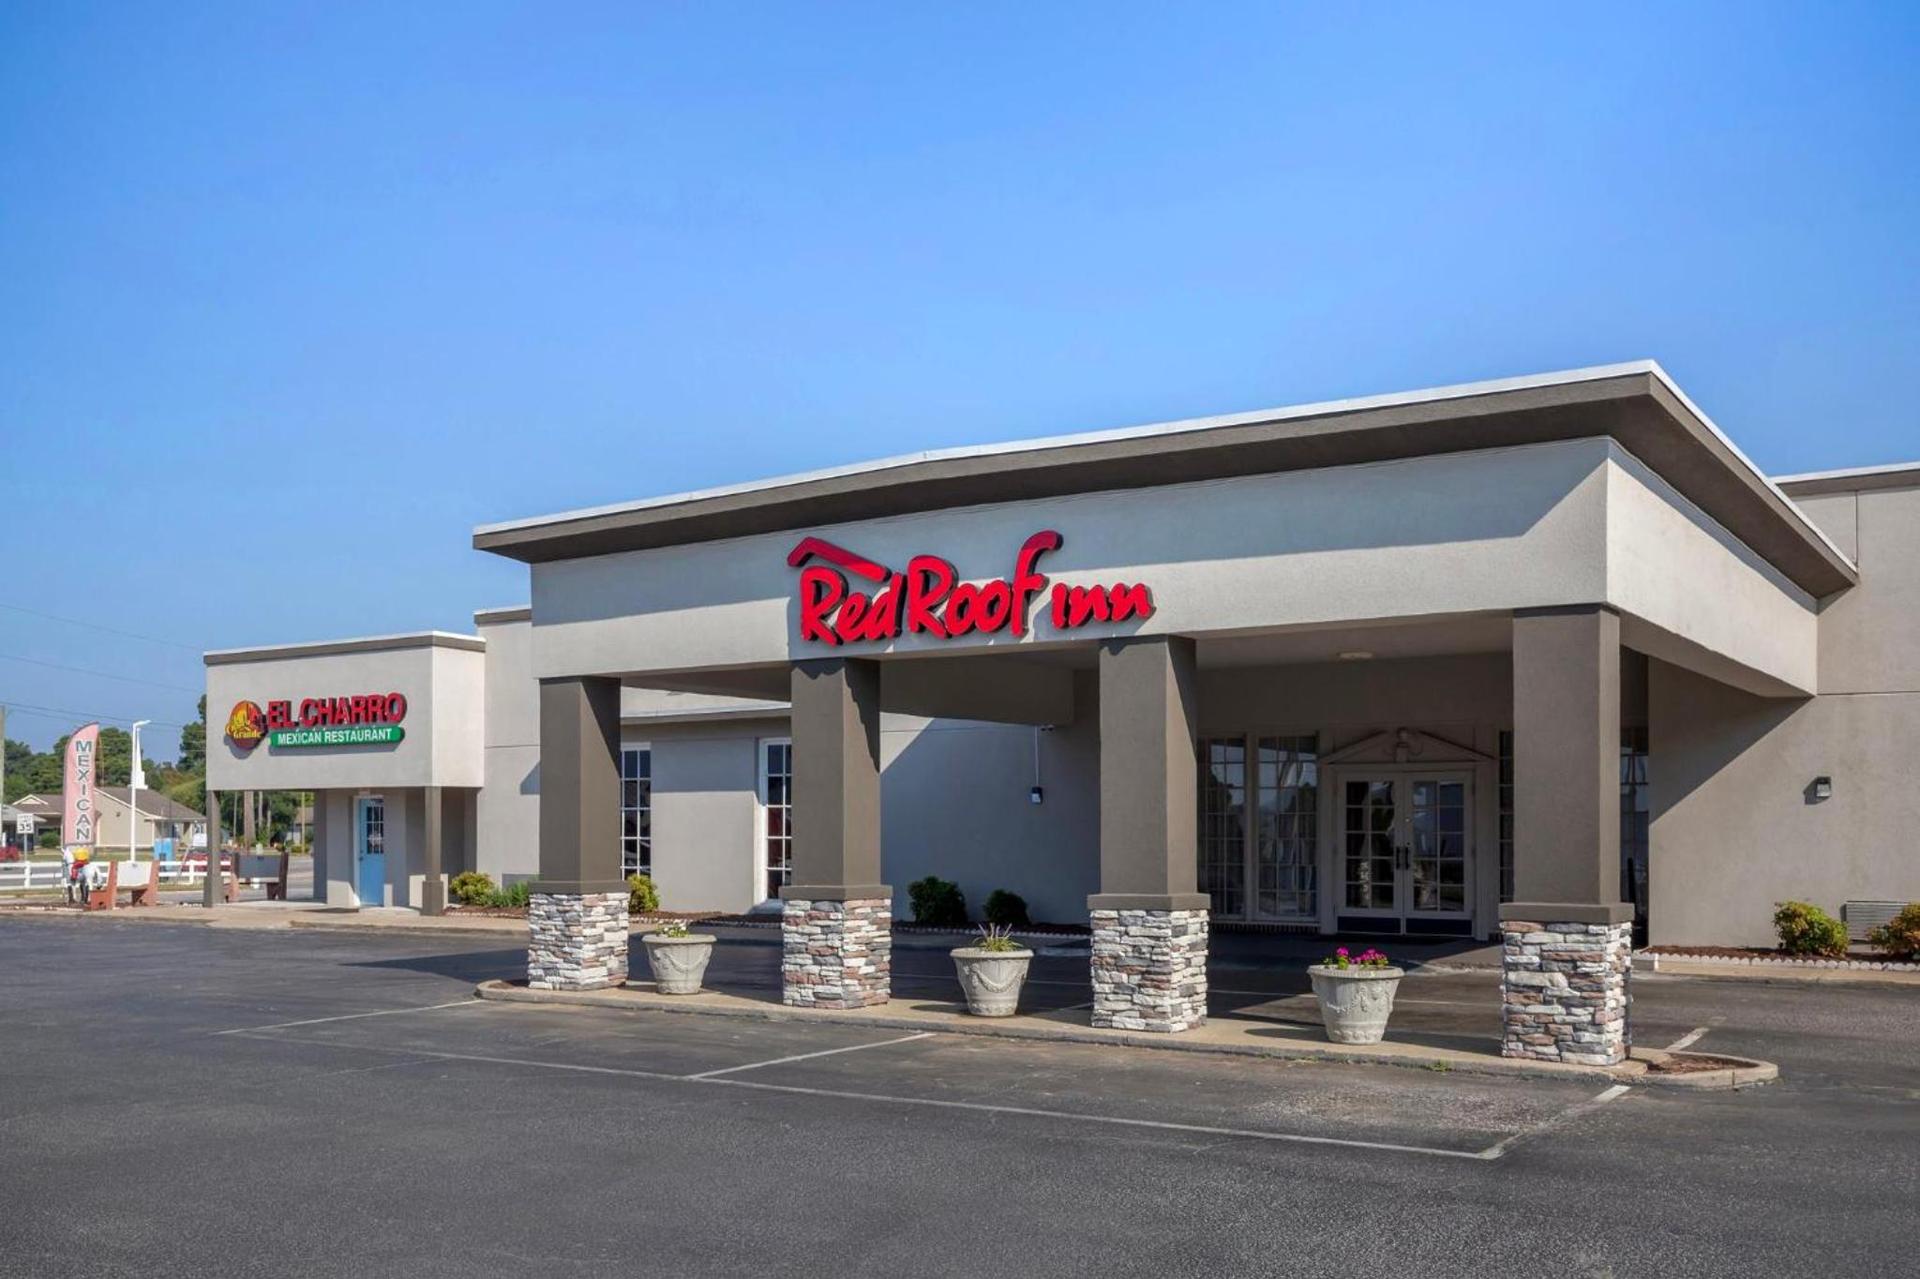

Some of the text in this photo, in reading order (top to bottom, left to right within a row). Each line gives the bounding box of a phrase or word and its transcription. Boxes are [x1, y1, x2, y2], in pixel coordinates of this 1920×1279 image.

[801, 565, 905, 646] Red
[907, 530, 1060, 639] Roof
[267, 700, 295, 729] EL
[299, 692, 406, 727] CHARRO
[277, 728, 393, 745] MEXICAN RESTAURANT
[75, 740, 93, 840] MEXICAN
[19, 823, 32, 831] 35
